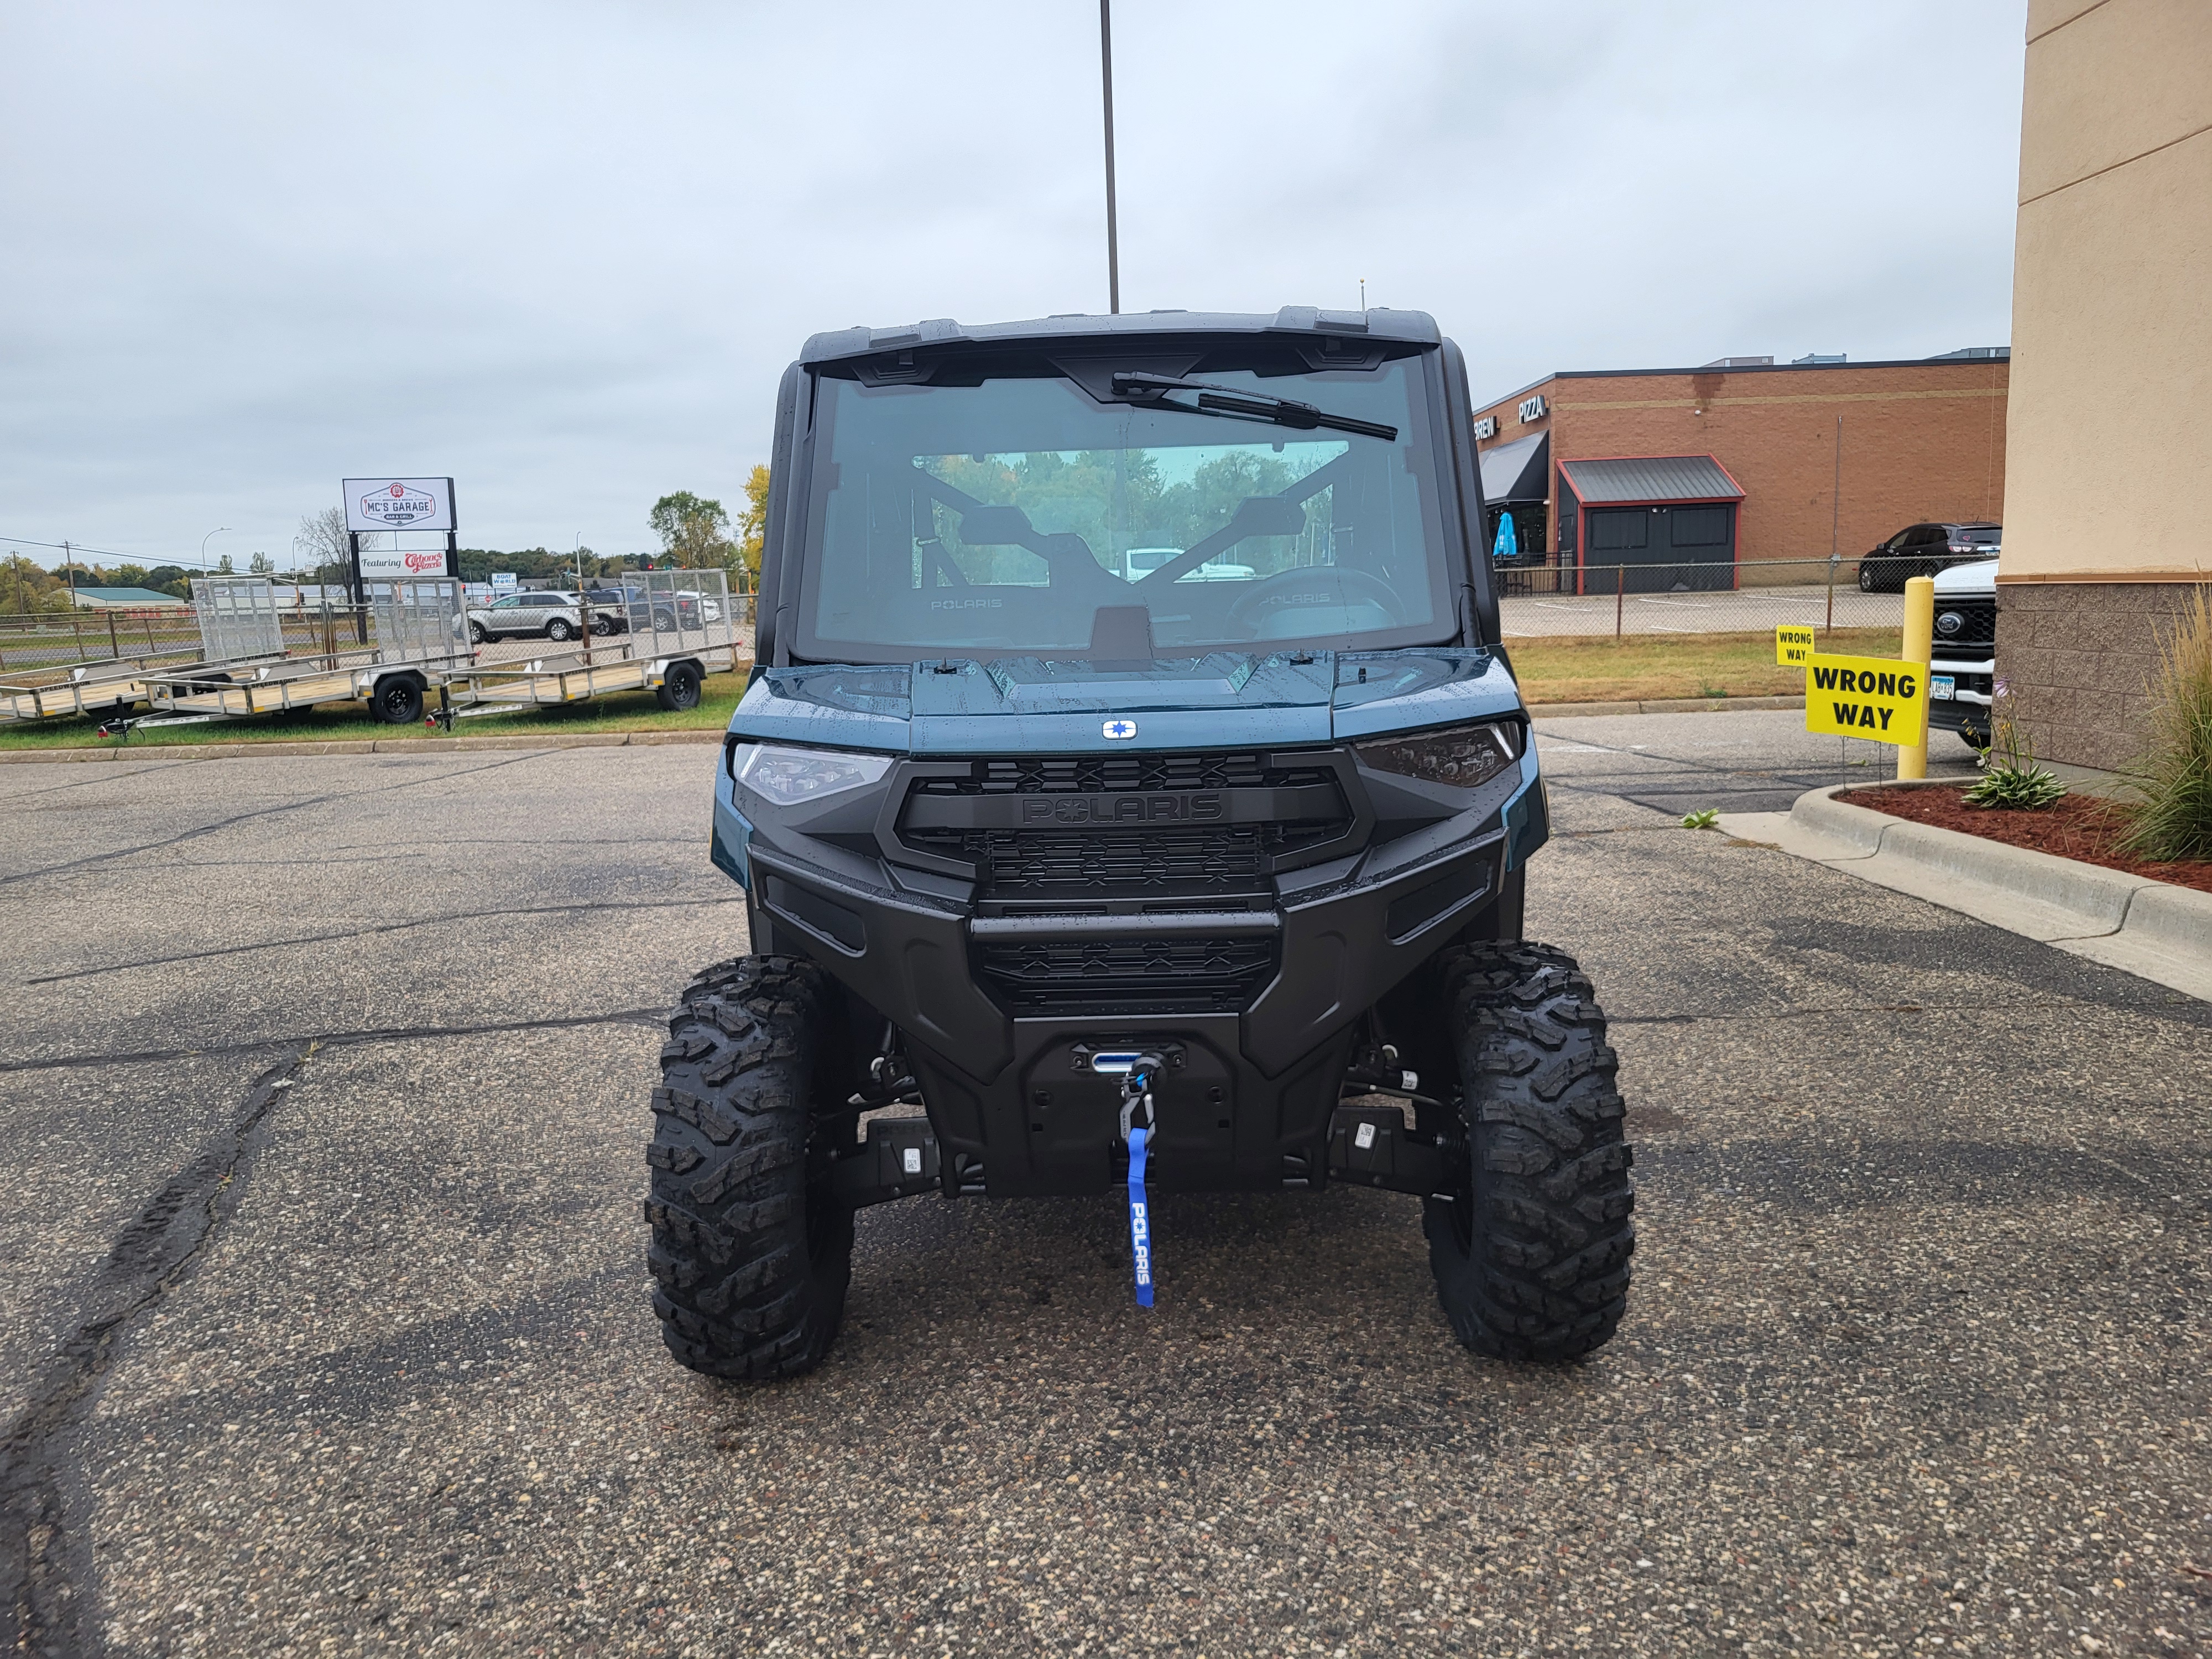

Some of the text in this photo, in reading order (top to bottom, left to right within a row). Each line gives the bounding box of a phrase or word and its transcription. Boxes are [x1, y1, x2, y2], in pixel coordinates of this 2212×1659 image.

[1519, 395, 1545, 425] PIZZA
[1474, 416, 1494, 441] BREW
[368, 502, 429, 512] MC'S GARAGE
[361, 559, 401, 568] Featuring
[931, 599, 1002, 610] POLARIS
[1941, 619, 1954, 629] Ford
[1779, 632, 1812, 645] WRONG
[247, 652, 280, 661] STAINLESS
[1786, 649, 1806, 661] WAY
[40, 681, 90, 693] SPEEDWAGON
[252, 678, 298, 688] SPEEDWAGON
[1813, 666, 1916, 698] WRONG
[1833, 702, 1894, 731] WAY
[1024, 794, 1223, 824] POLARIS
[1131, 1202, 1150, 1286] POLARIS
